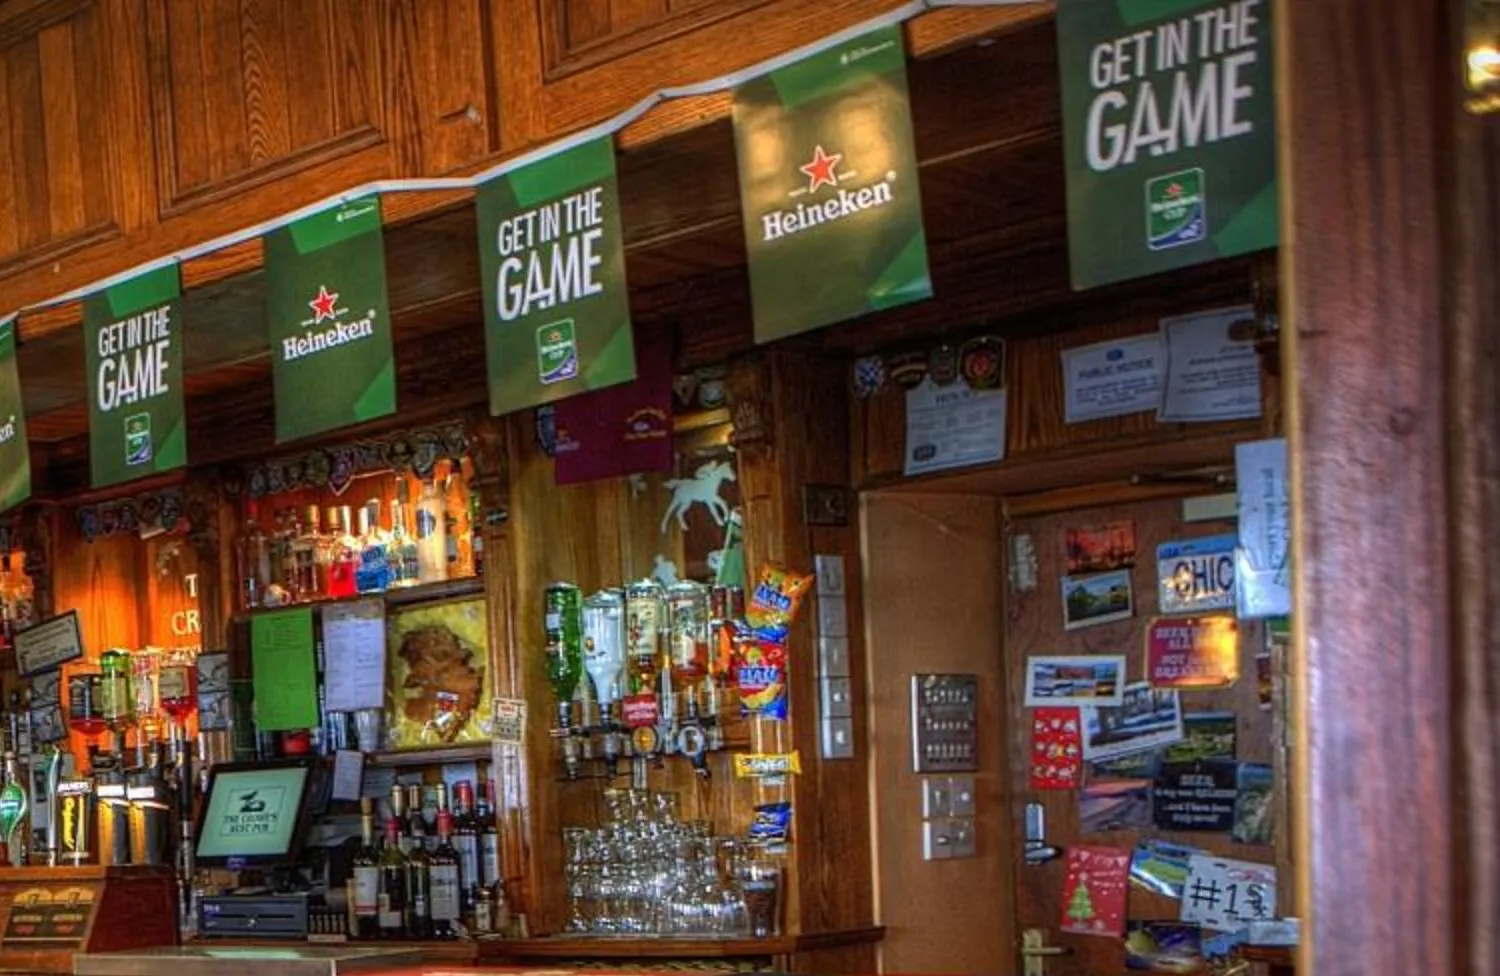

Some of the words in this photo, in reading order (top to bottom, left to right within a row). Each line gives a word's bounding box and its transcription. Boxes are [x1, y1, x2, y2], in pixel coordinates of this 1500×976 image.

[1090, 31, 1152, 89] GET
[1156, 17, 1189, 72] IN
[1195, 1, 1260, 55] THE
[1086, 51, 1258, 172] GAME
[499, 208, 536, 256] GET
[538, 200, 562, 244] IN
[563, 187, 602, 232] THE
[762, 179, 894, 241] Heineken
[497, 228, 602, 320] GAME
[99, 324, 126, 356] GET
[127, 316, 142, 346] IN
[143, 306, 171, 339] THE
[283, 318, 373, 360] Heineken
[98, 340, 170, 411] GAME
[1173, 555, 1234, 598] CHIC
